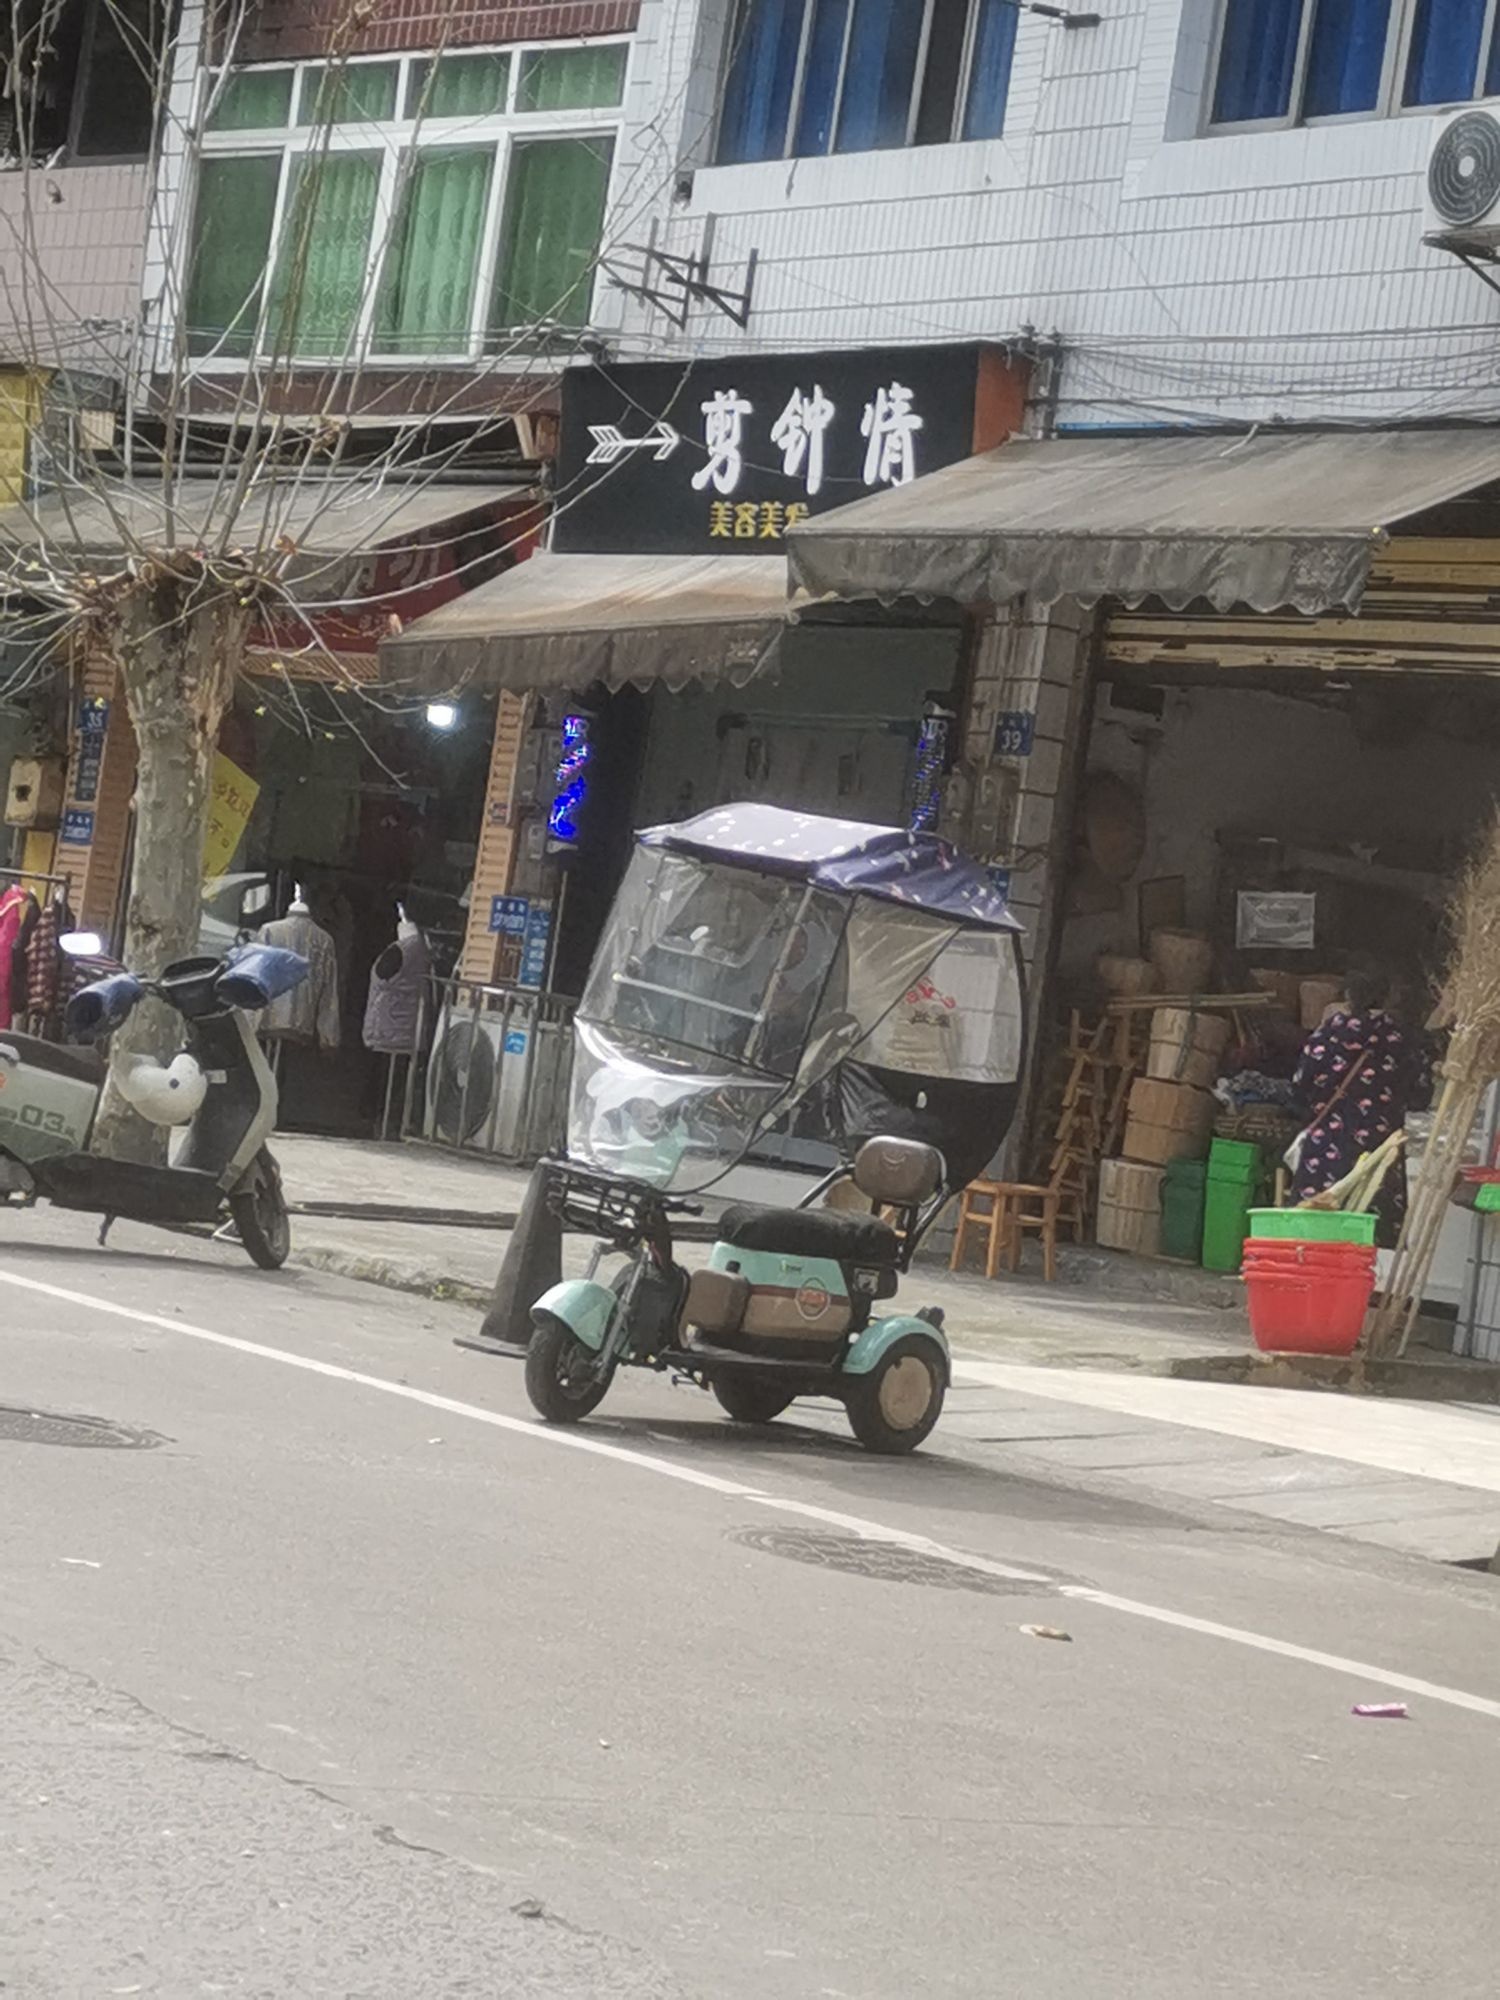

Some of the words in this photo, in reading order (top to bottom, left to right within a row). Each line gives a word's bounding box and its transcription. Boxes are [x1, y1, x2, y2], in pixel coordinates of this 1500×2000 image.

[691, 383, 924, 494] 剪钟情
[1001, 730, 1022, 750] 39
